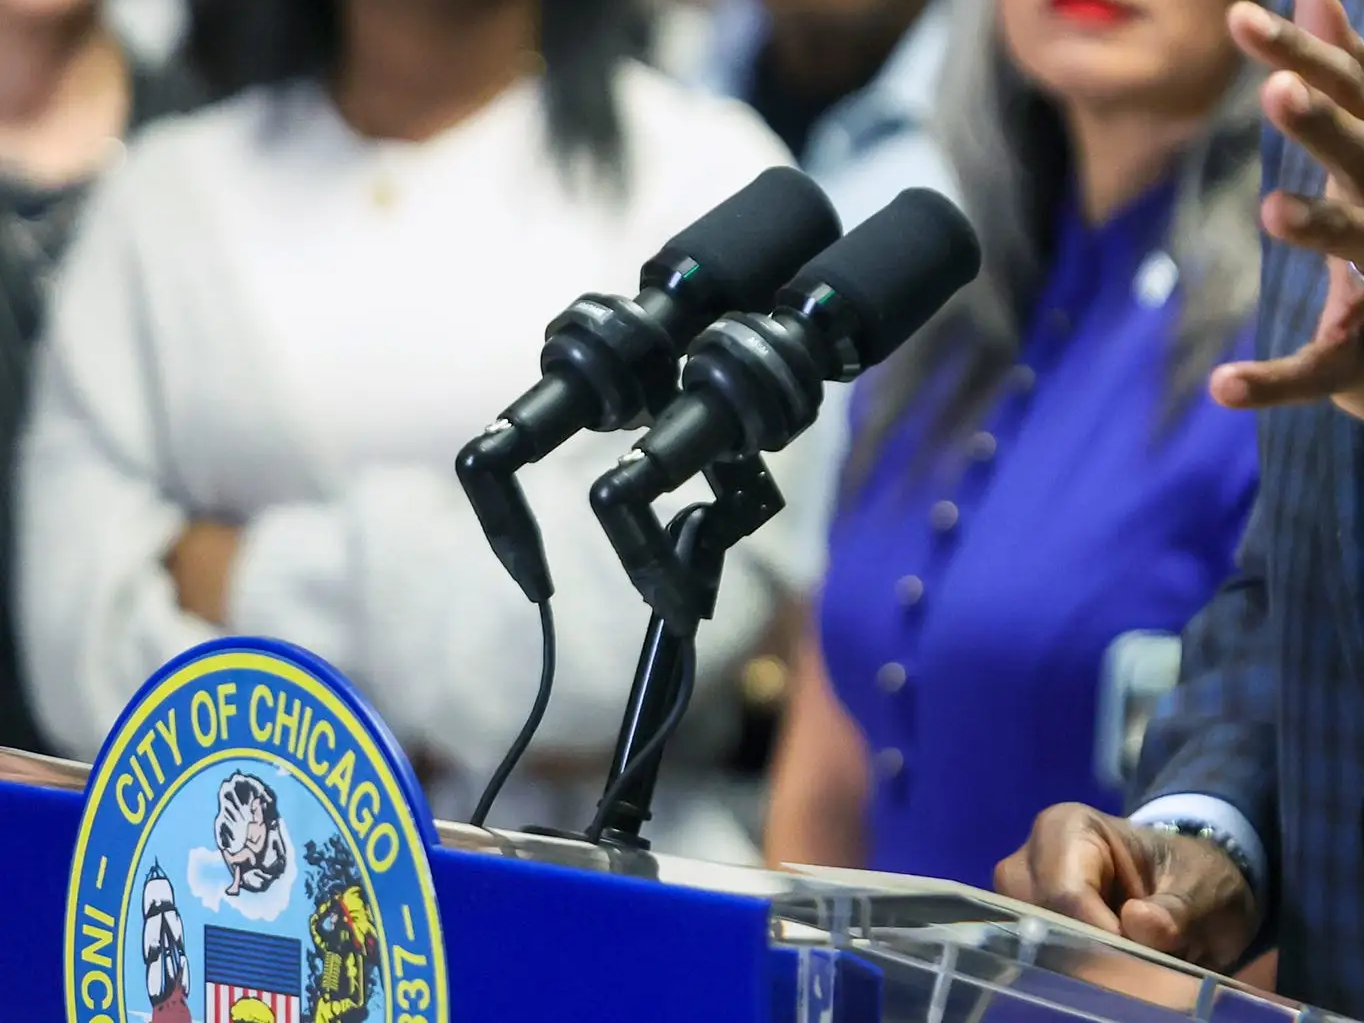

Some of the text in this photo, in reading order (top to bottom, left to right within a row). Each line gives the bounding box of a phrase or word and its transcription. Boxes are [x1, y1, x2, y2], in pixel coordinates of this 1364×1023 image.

[115, 682, 400, 873] CITY OF CHICAGO
[81, 904, 116, 1023] INC
